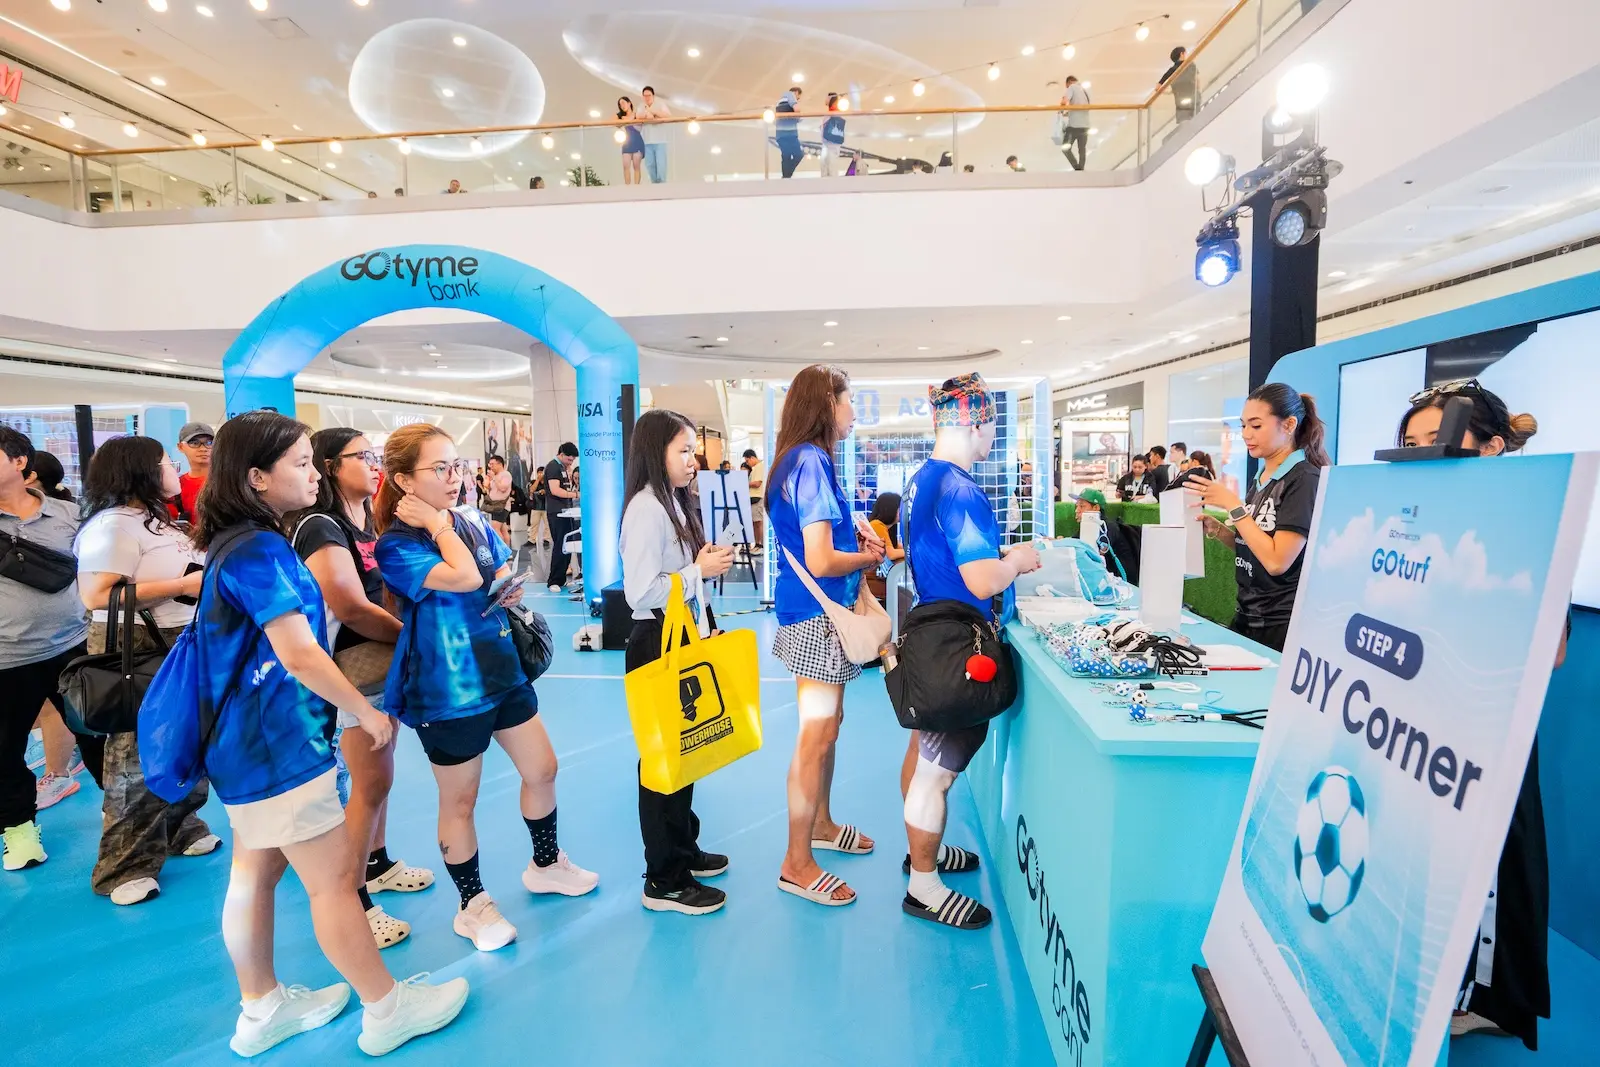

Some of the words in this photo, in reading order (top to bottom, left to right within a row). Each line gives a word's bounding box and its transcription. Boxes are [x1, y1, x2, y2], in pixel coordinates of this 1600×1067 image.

[340, 252, 479, 287] GOtyme
[426, 278, 480, 301] bank
[1066, 393, 1108, 413] MAC
[583, 448, 616, 457] GOtyme
[1371, 547, 1431, 583] GOturf
[1356, 626, 1393, 659] STEP
[1393, 641, 1408, 667] 4
[680, 717, 732, 751] OWERHOUSE
[1290, 647, 1343, 714] DIY
[1342, 679, 1483, 811] Corner
[1016, 814, 1091, 1044] GOtyme
